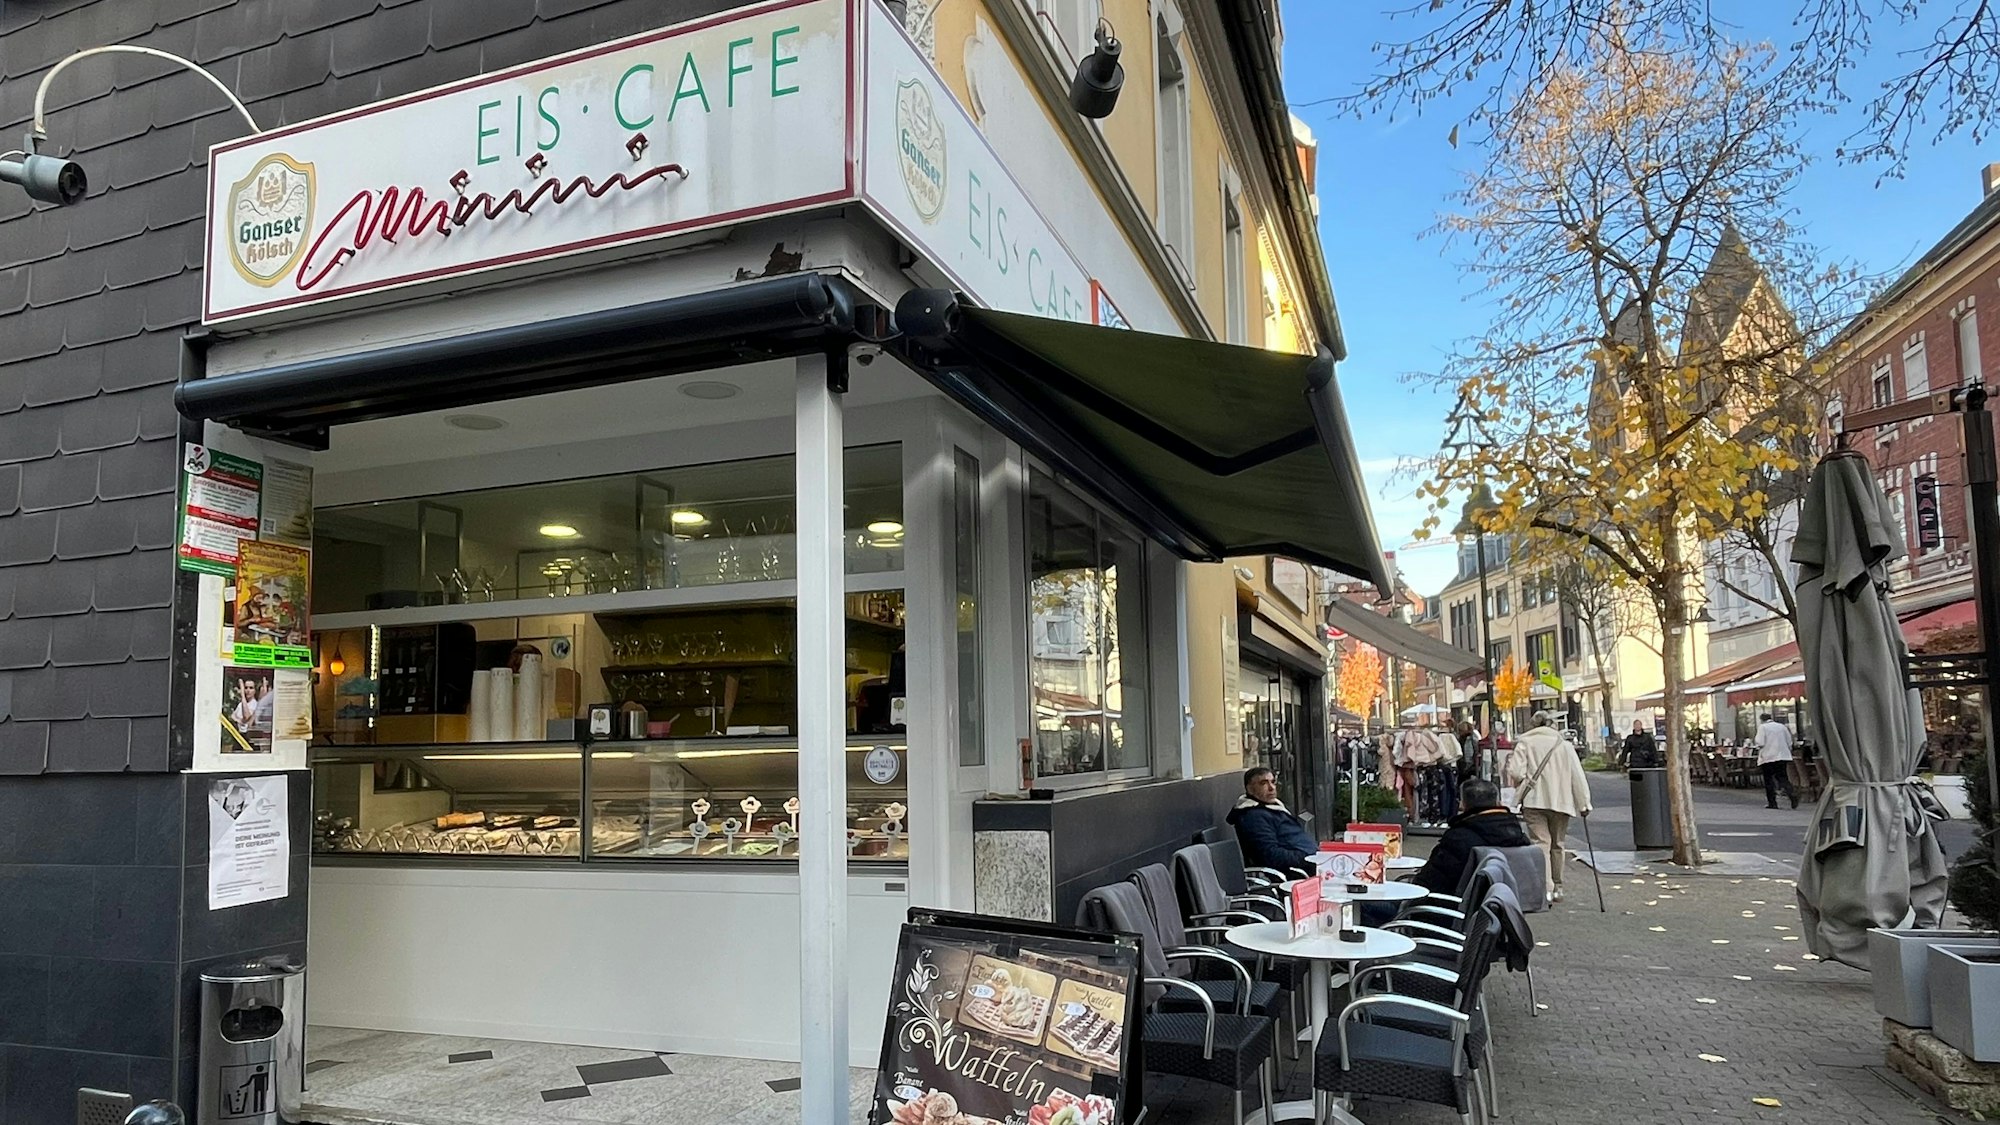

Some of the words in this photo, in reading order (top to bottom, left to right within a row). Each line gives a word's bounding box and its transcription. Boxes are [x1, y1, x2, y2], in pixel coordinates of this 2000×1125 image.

[477, 86, 560, 165] EIS
[615, 26, 800, 131] CAFE
[902, 128, 940, 190] Ganser
[240, 215, 301, 244] Ganser
[246, 237, 293, 264] Kölsch
[969, 169, 1008, 275] EIS
[1917, 481, 1938, 542] CAFE
[1080, 990, 1112, 1011] Nutella
[893, 1071, 924, 1088] Banane
[934, 1032, 1046, 1103] Waffeln
